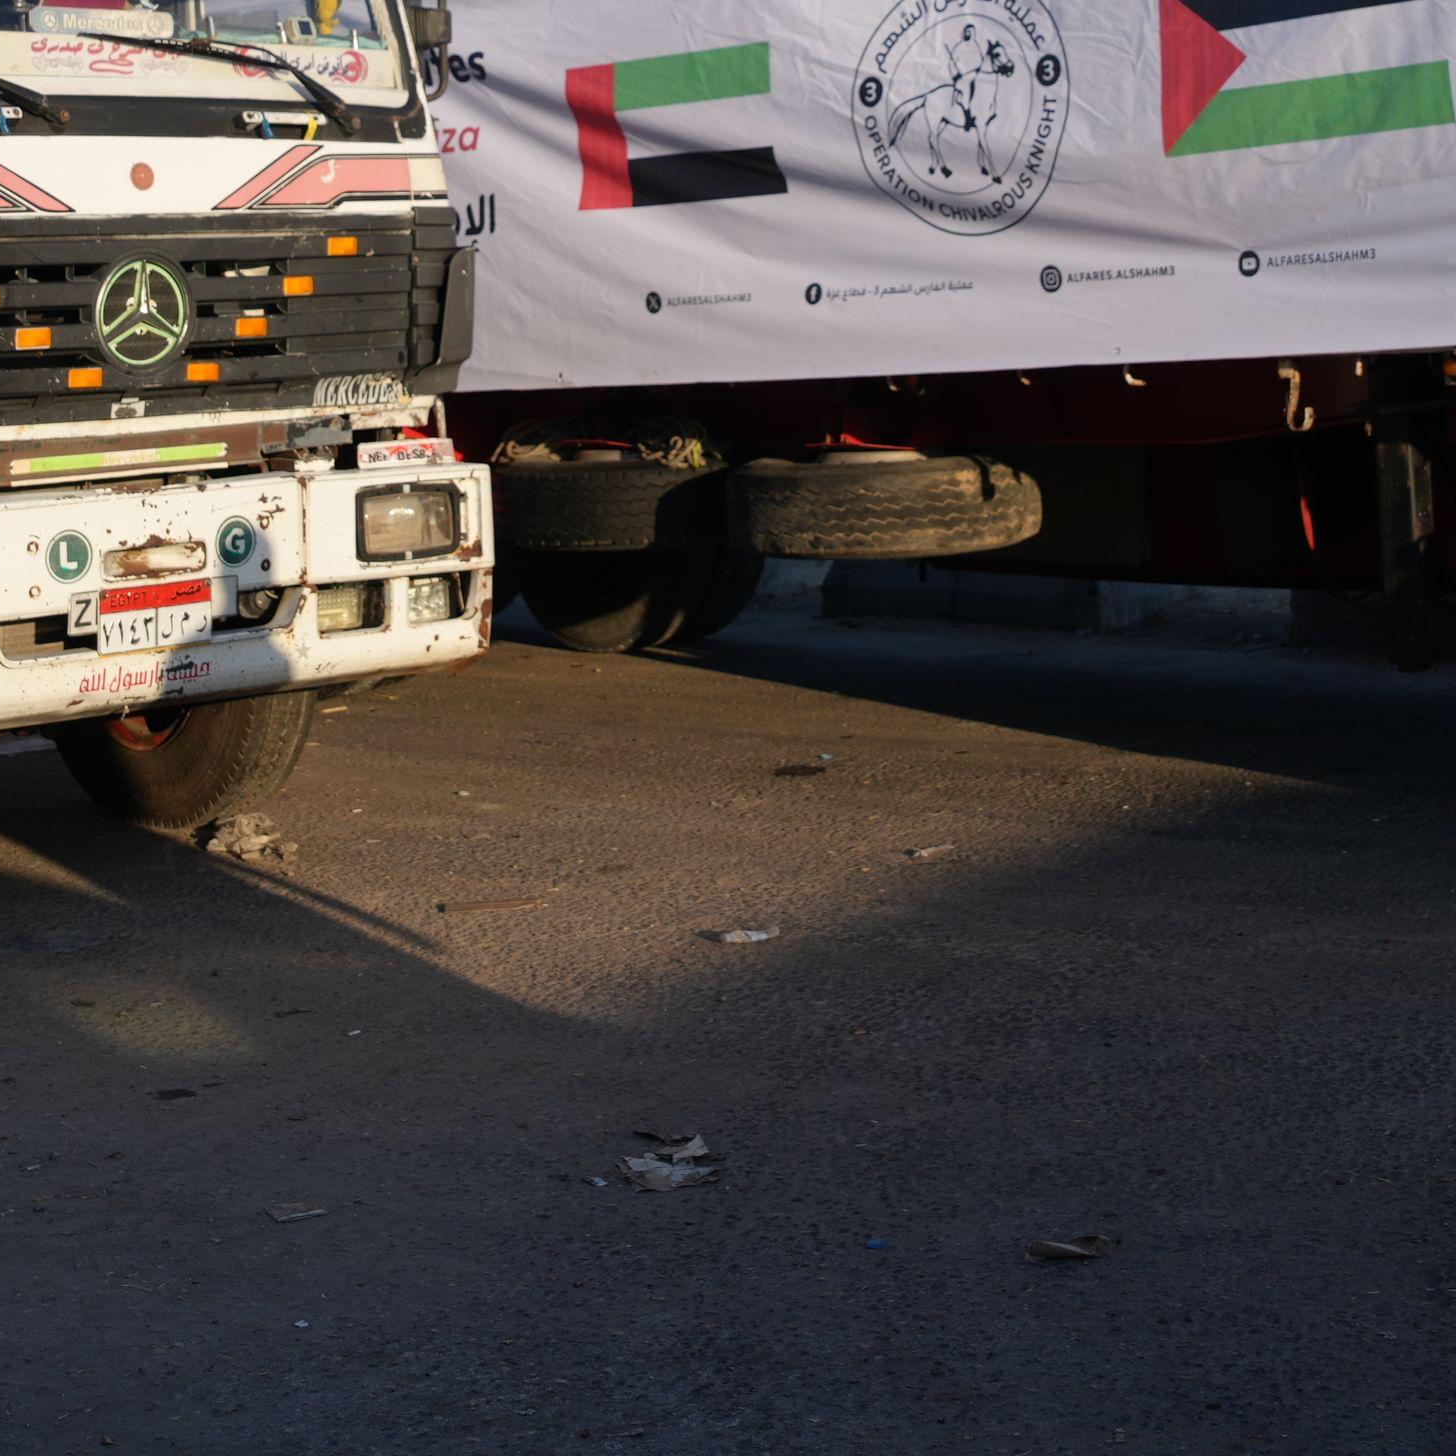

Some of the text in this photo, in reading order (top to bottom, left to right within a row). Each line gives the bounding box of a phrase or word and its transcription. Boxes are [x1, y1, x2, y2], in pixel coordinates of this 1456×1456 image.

[864, 94, 1057, 222] OPERATION CHIVALROUS KNIGHT
[1267, 248, 1376, 268] ALFARESALSHAHM3
[1067, 265, 1175, 283] ALFARES.ALSHAHM3
[225, 527, 245, 553] G
[59, 540, 78, 571] L
[110, 591, 146, 608] EGYPT
[171, 584, 202, 601] مصر
